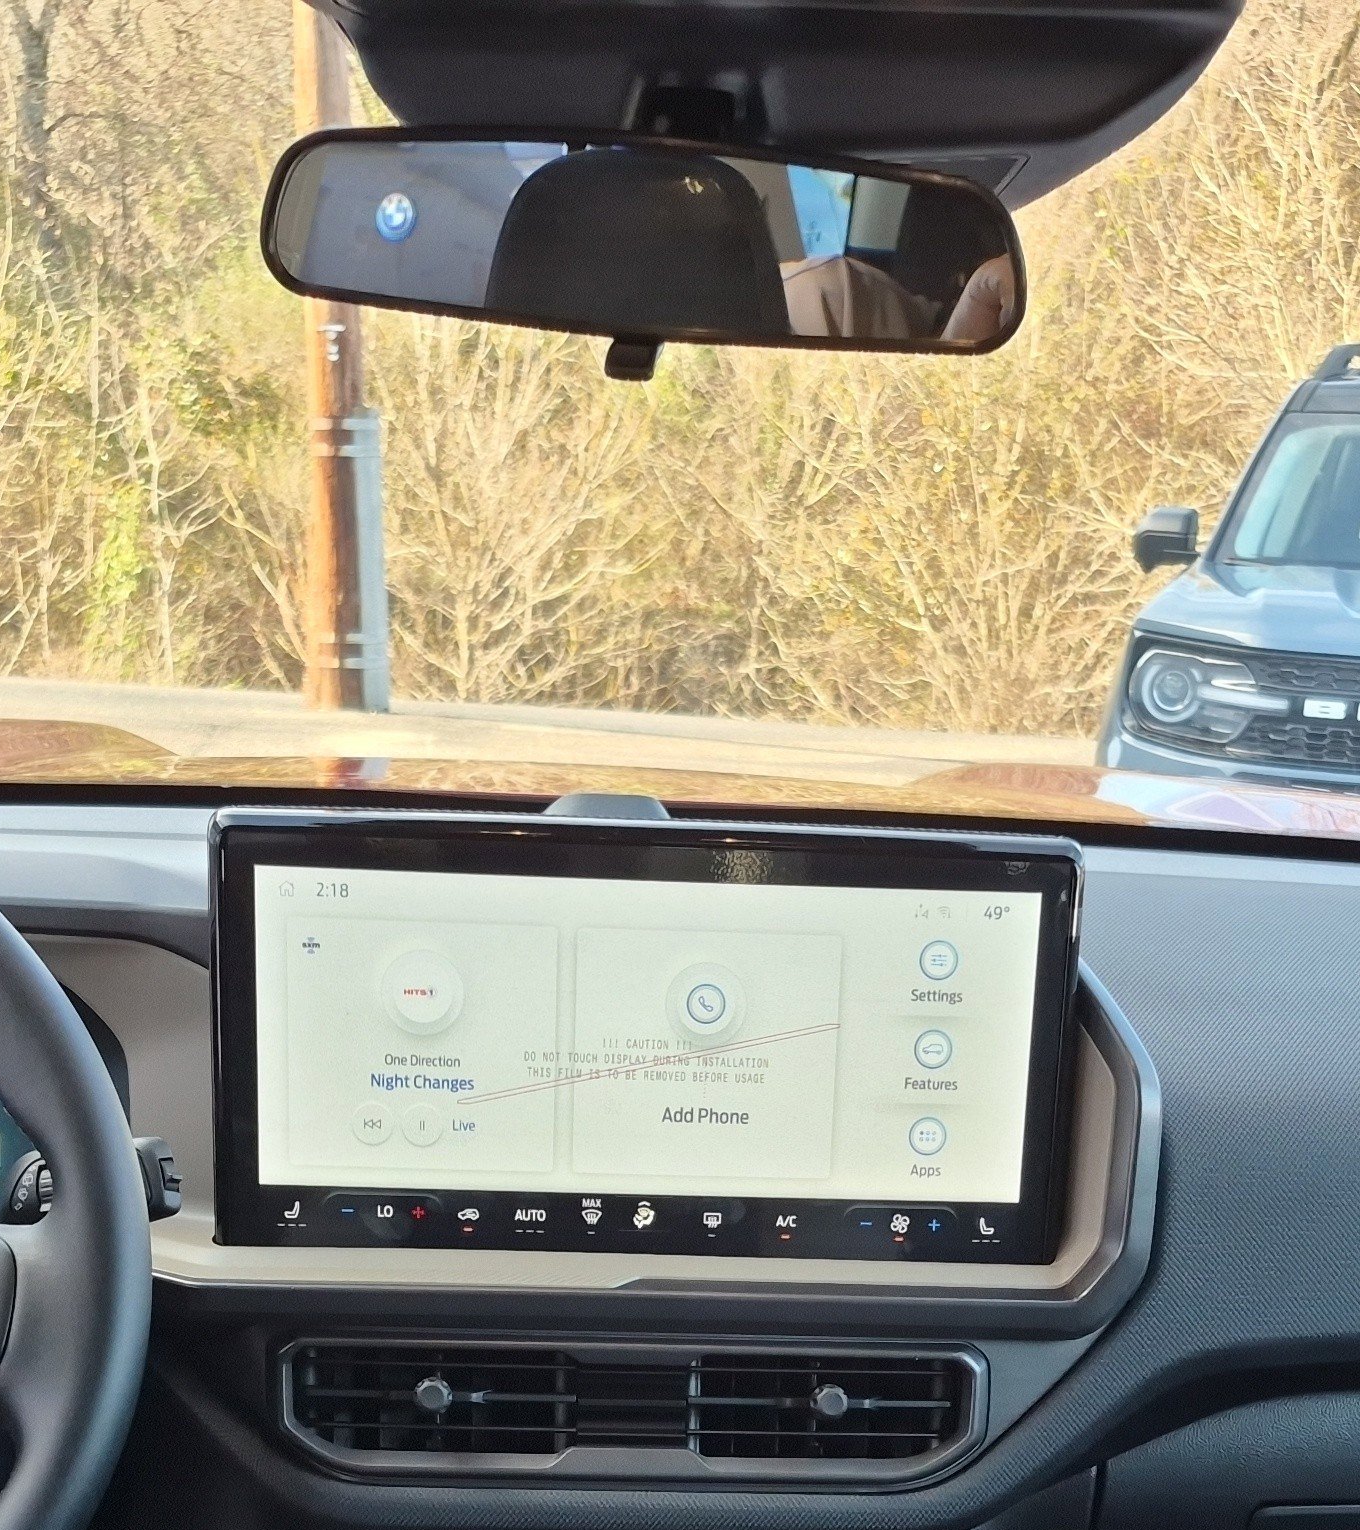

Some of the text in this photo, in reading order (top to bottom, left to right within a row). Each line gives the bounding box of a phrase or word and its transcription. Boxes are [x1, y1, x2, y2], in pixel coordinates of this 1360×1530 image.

[316, 882, 349, 898] 2:18
[910, 988, 963, 1005] Settings
[626, 1039, 669, 1050] CAUTION
[384, 1053, 461, 1068] One Direction
[523, 1051, 769, 1068] DO NOT TOUCH DISPLAY DURING INSTALLATION
[527, 1066, 551, 1078] THIS
[589, 1068, 601, 1080] IS
[608, 1069, 619, 1080] TO
[625, 1069, 637, 1080] BE
[643, 1070, 686, 1082] REMOVED
[692, 1072, 728, 1083] BEFORE
[735, 1073, 765, 1084] USAGE
[371, 1073, 475, 1093] Night Changes
[903, 1076, 958, 1091] Features
[661, 1106, 749, 1125] Add Phone
[452, 1118, 476, 1132] Live
[910, 1163, 942, 1179] Apps
[582, 1198, 602, 1208] MAX
[377, 1204, 393, 1218] LO
[515, 1208, 546, 1222] AUTO
[775, 1214, 798, 1228] A/C
